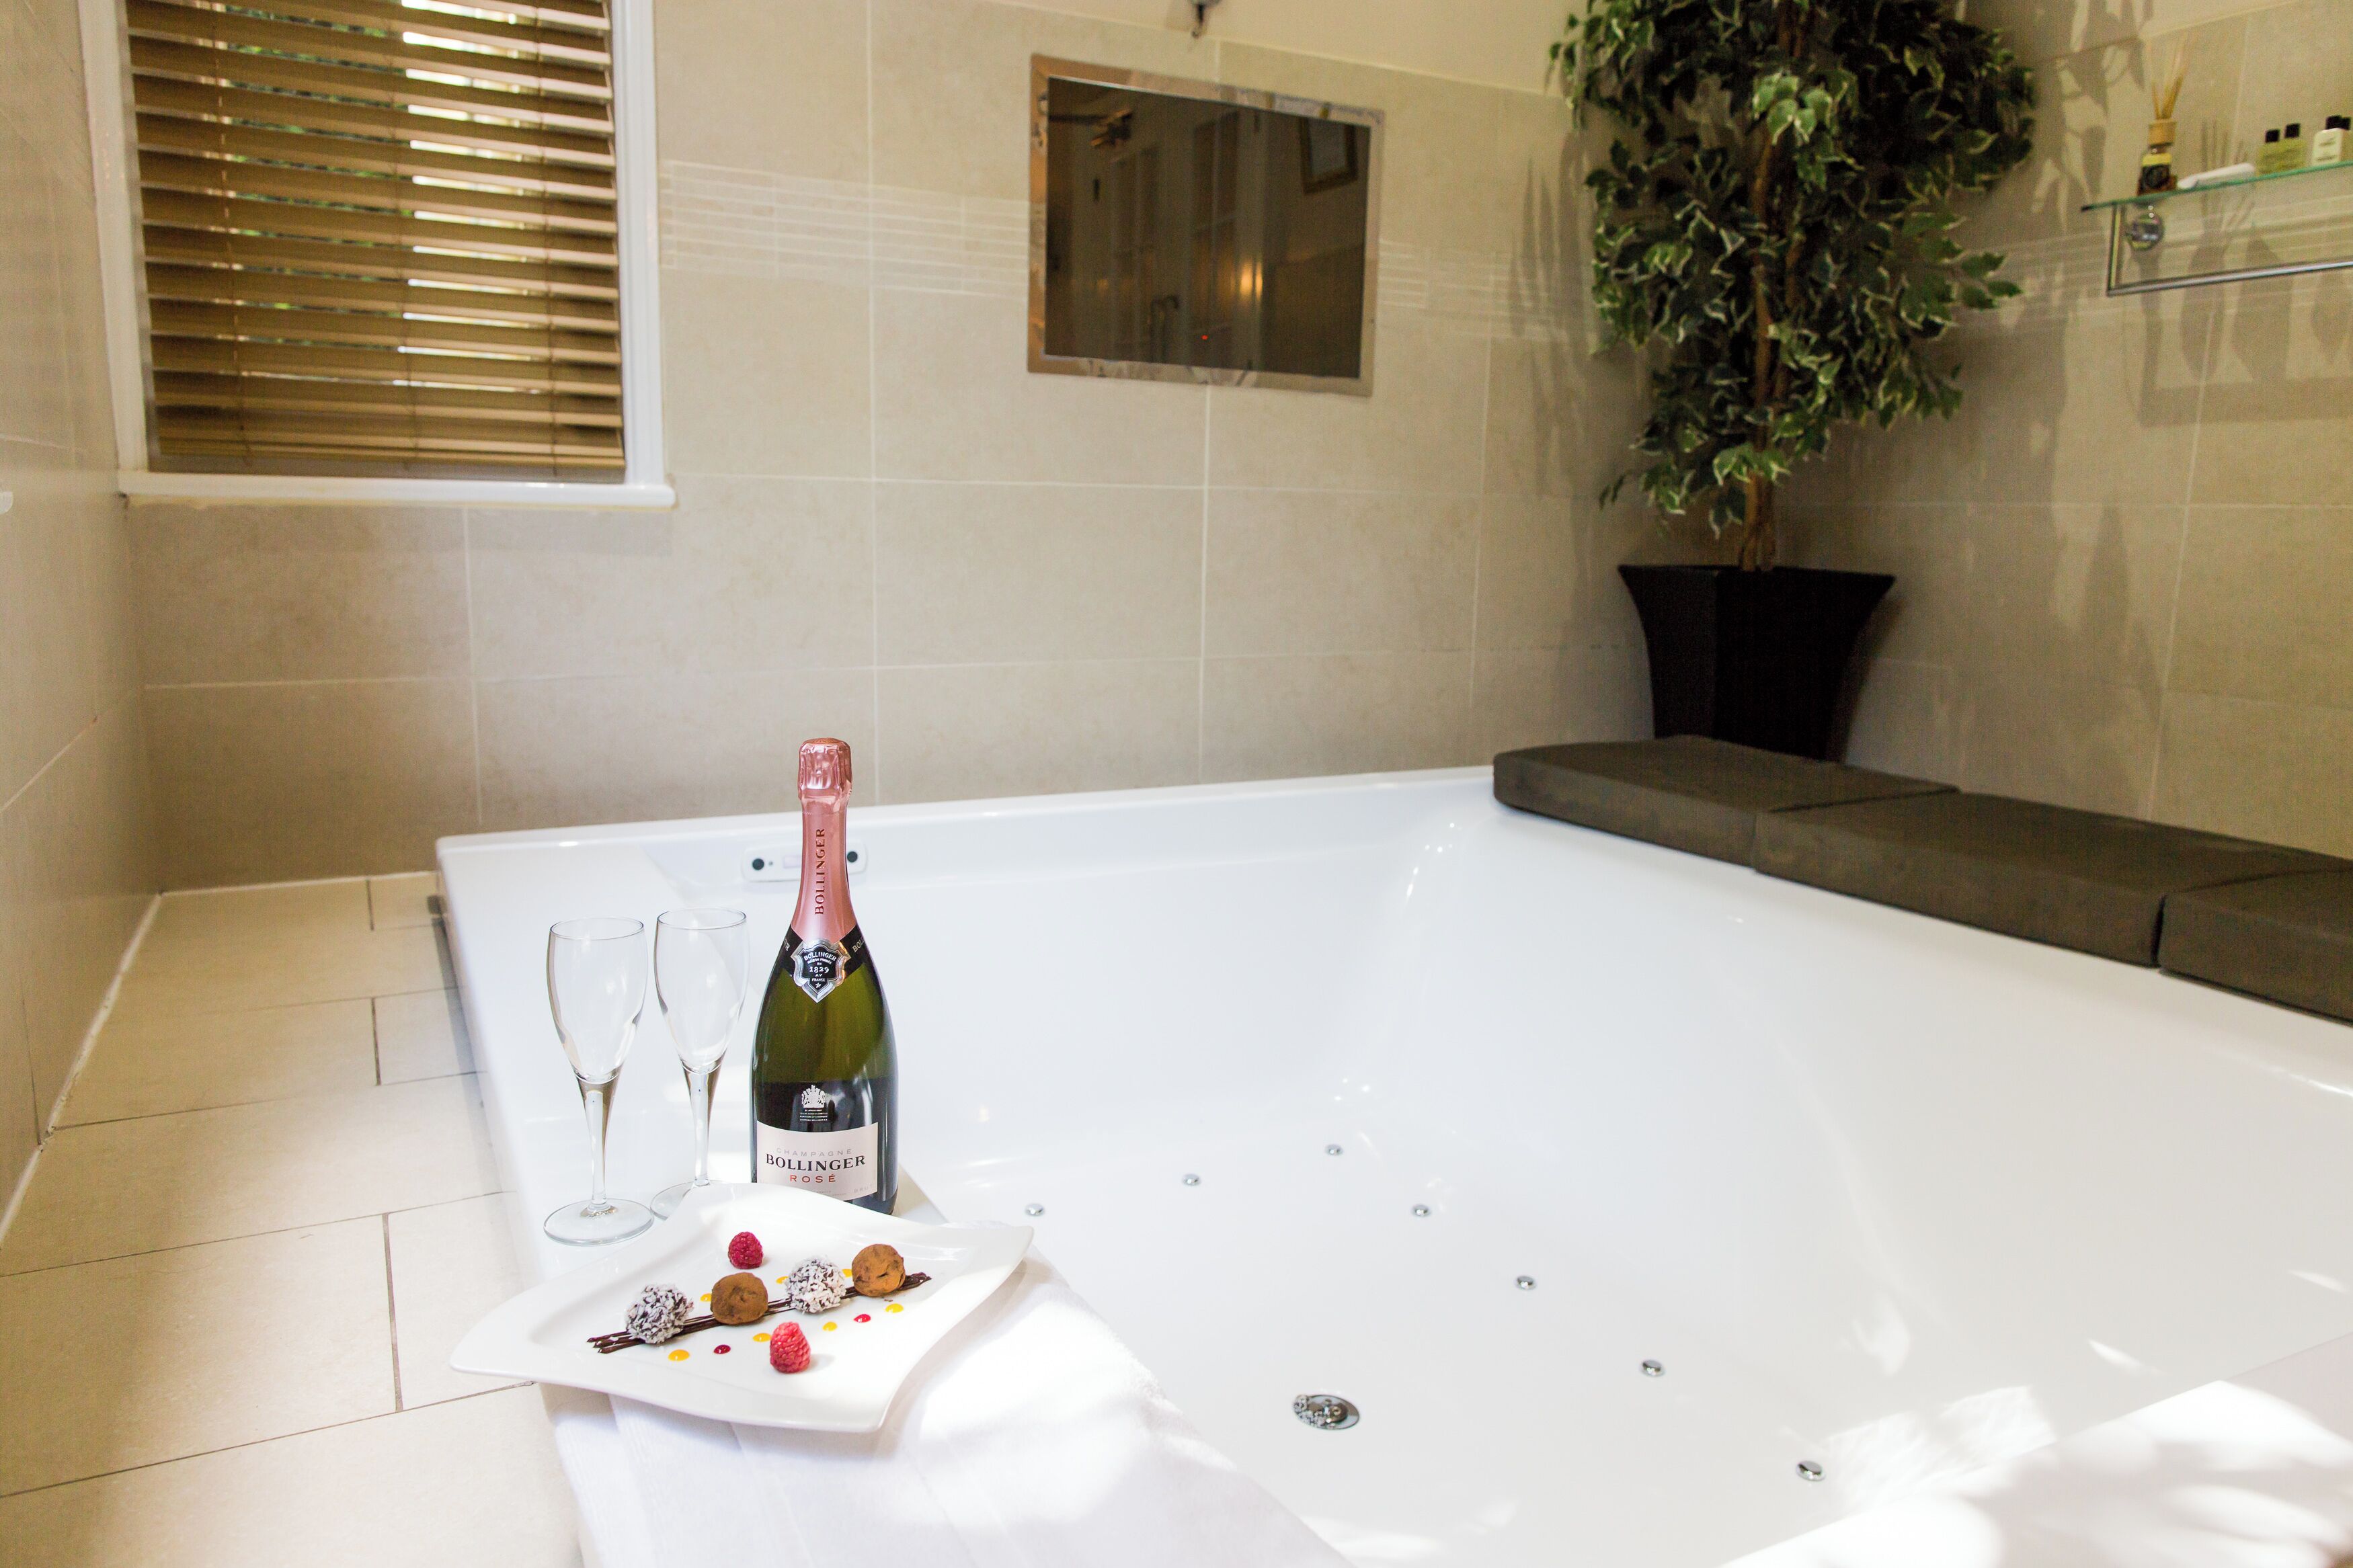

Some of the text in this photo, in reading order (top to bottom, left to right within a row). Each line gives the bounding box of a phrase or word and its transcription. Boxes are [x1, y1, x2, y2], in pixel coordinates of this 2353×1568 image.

[815, 829, 826, 915] BOLLINGER
[803, 951, 837, 961] BOLLINGER
[776, 1147, 852, 1157] CHAMPAGNE
[766, 1153, 866, 1171] BOLLINGER
[790, 1173, 836, 1183] ROSÉ
[854, 1184, 873, 1194] BRUT
